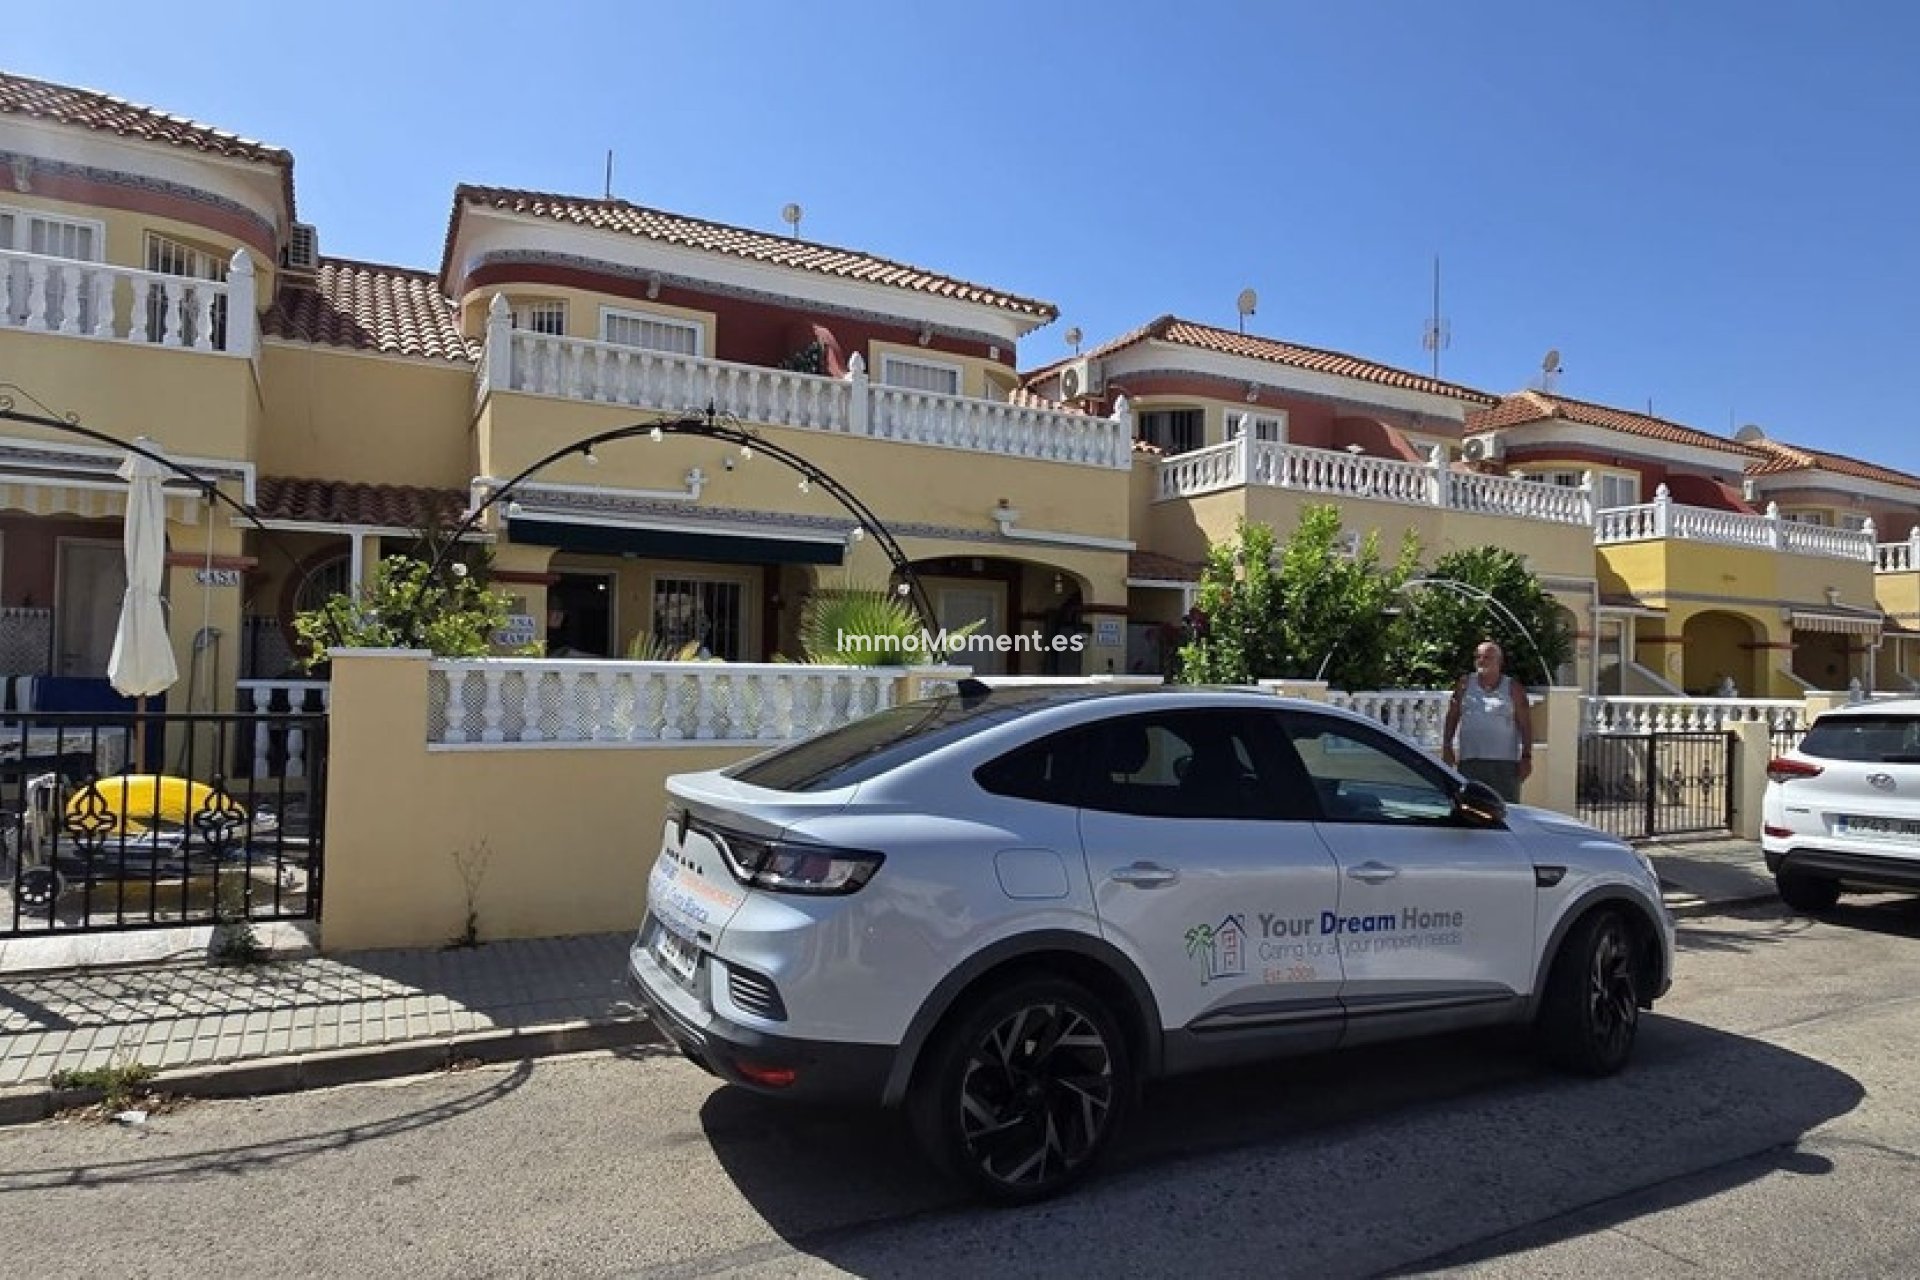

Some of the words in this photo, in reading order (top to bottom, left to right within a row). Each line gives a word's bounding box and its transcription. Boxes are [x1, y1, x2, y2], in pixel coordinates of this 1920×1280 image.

[1258, 912, 1314, 938] Your
[1320, 910, 1396, 935] Dream
[1402, 907, 1463, 930] Home
